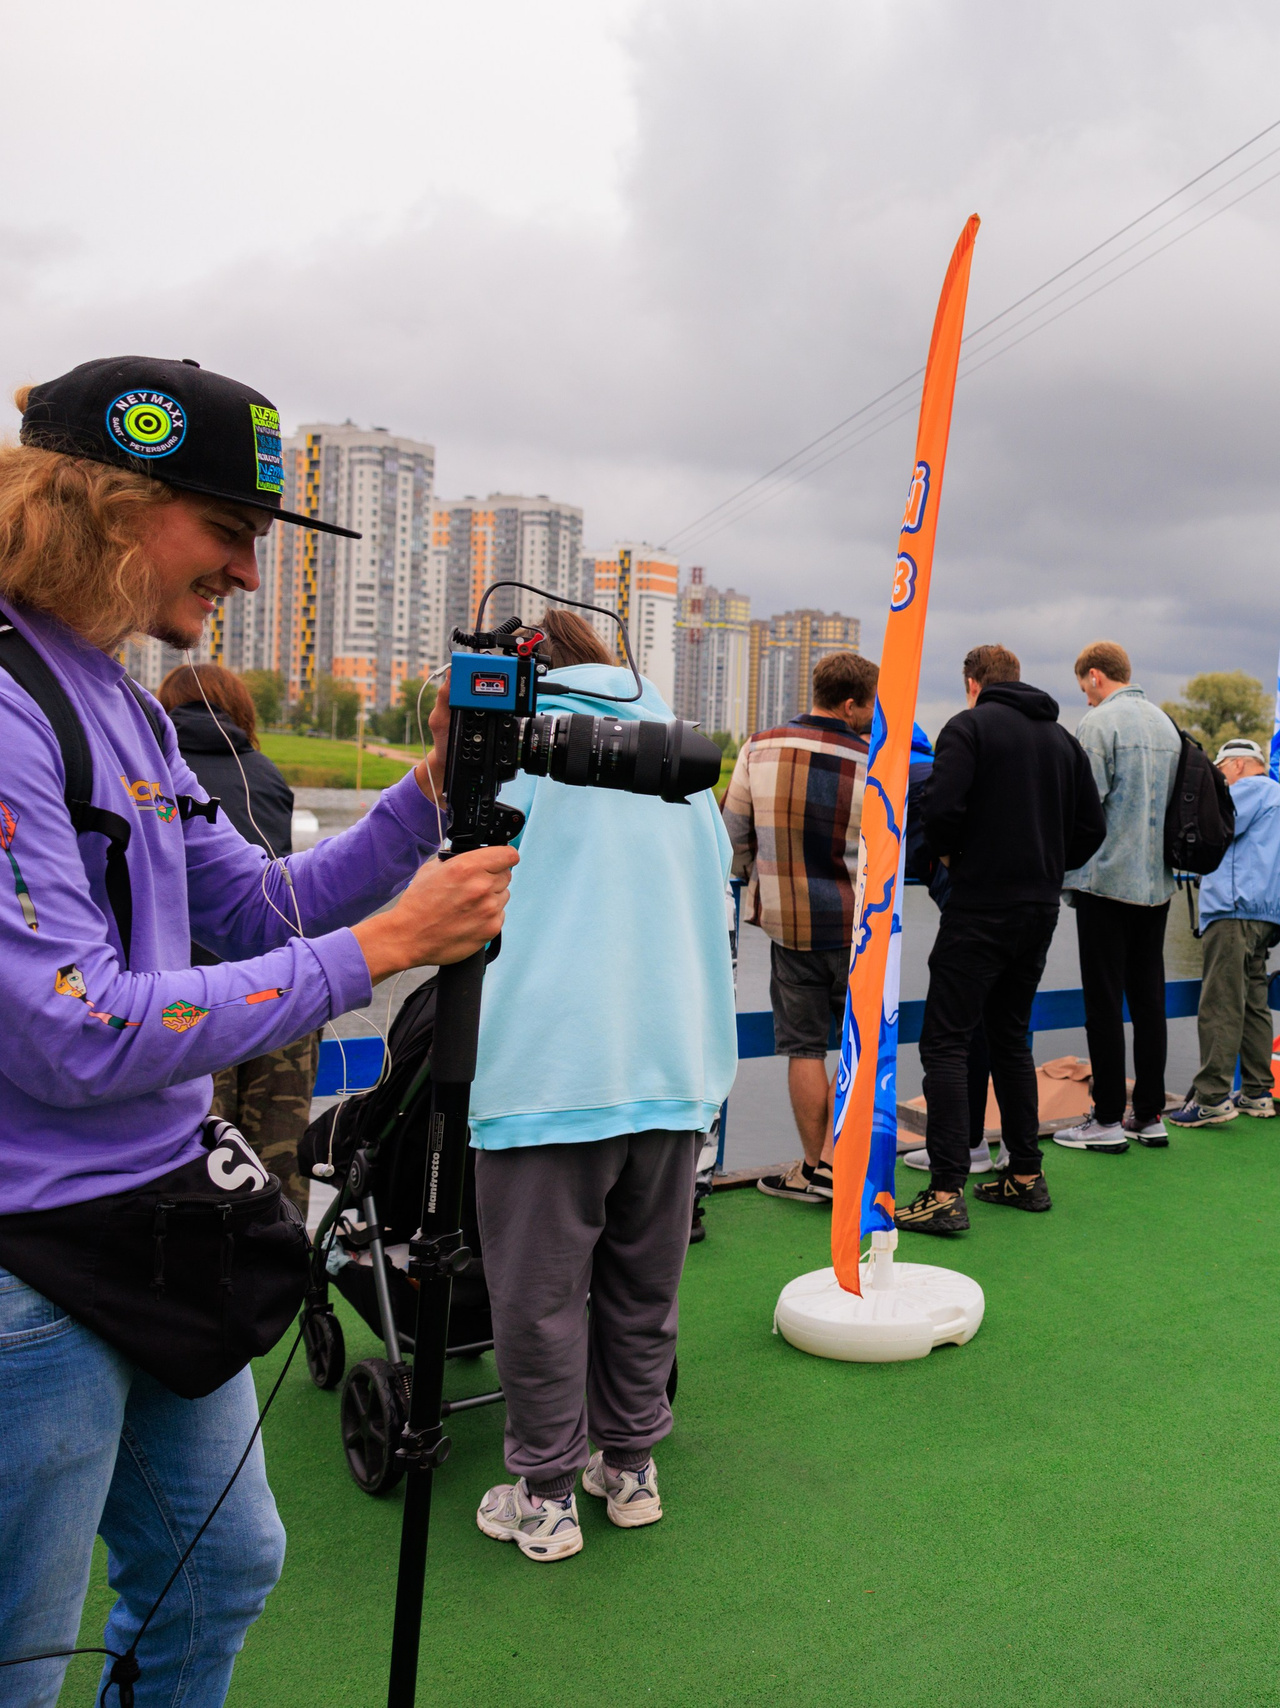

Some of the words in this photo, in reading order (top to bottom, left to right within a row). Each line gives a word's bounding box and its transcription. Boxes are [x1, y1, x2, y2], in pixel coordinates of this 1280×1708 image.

[115, 392, 184, 428] NEYMAXX
[112, 416, 125, 437] SAINT
[129, 435, 179, 453] PETERSBURG
[428, 1152, 440, 1213] Manfrotto
